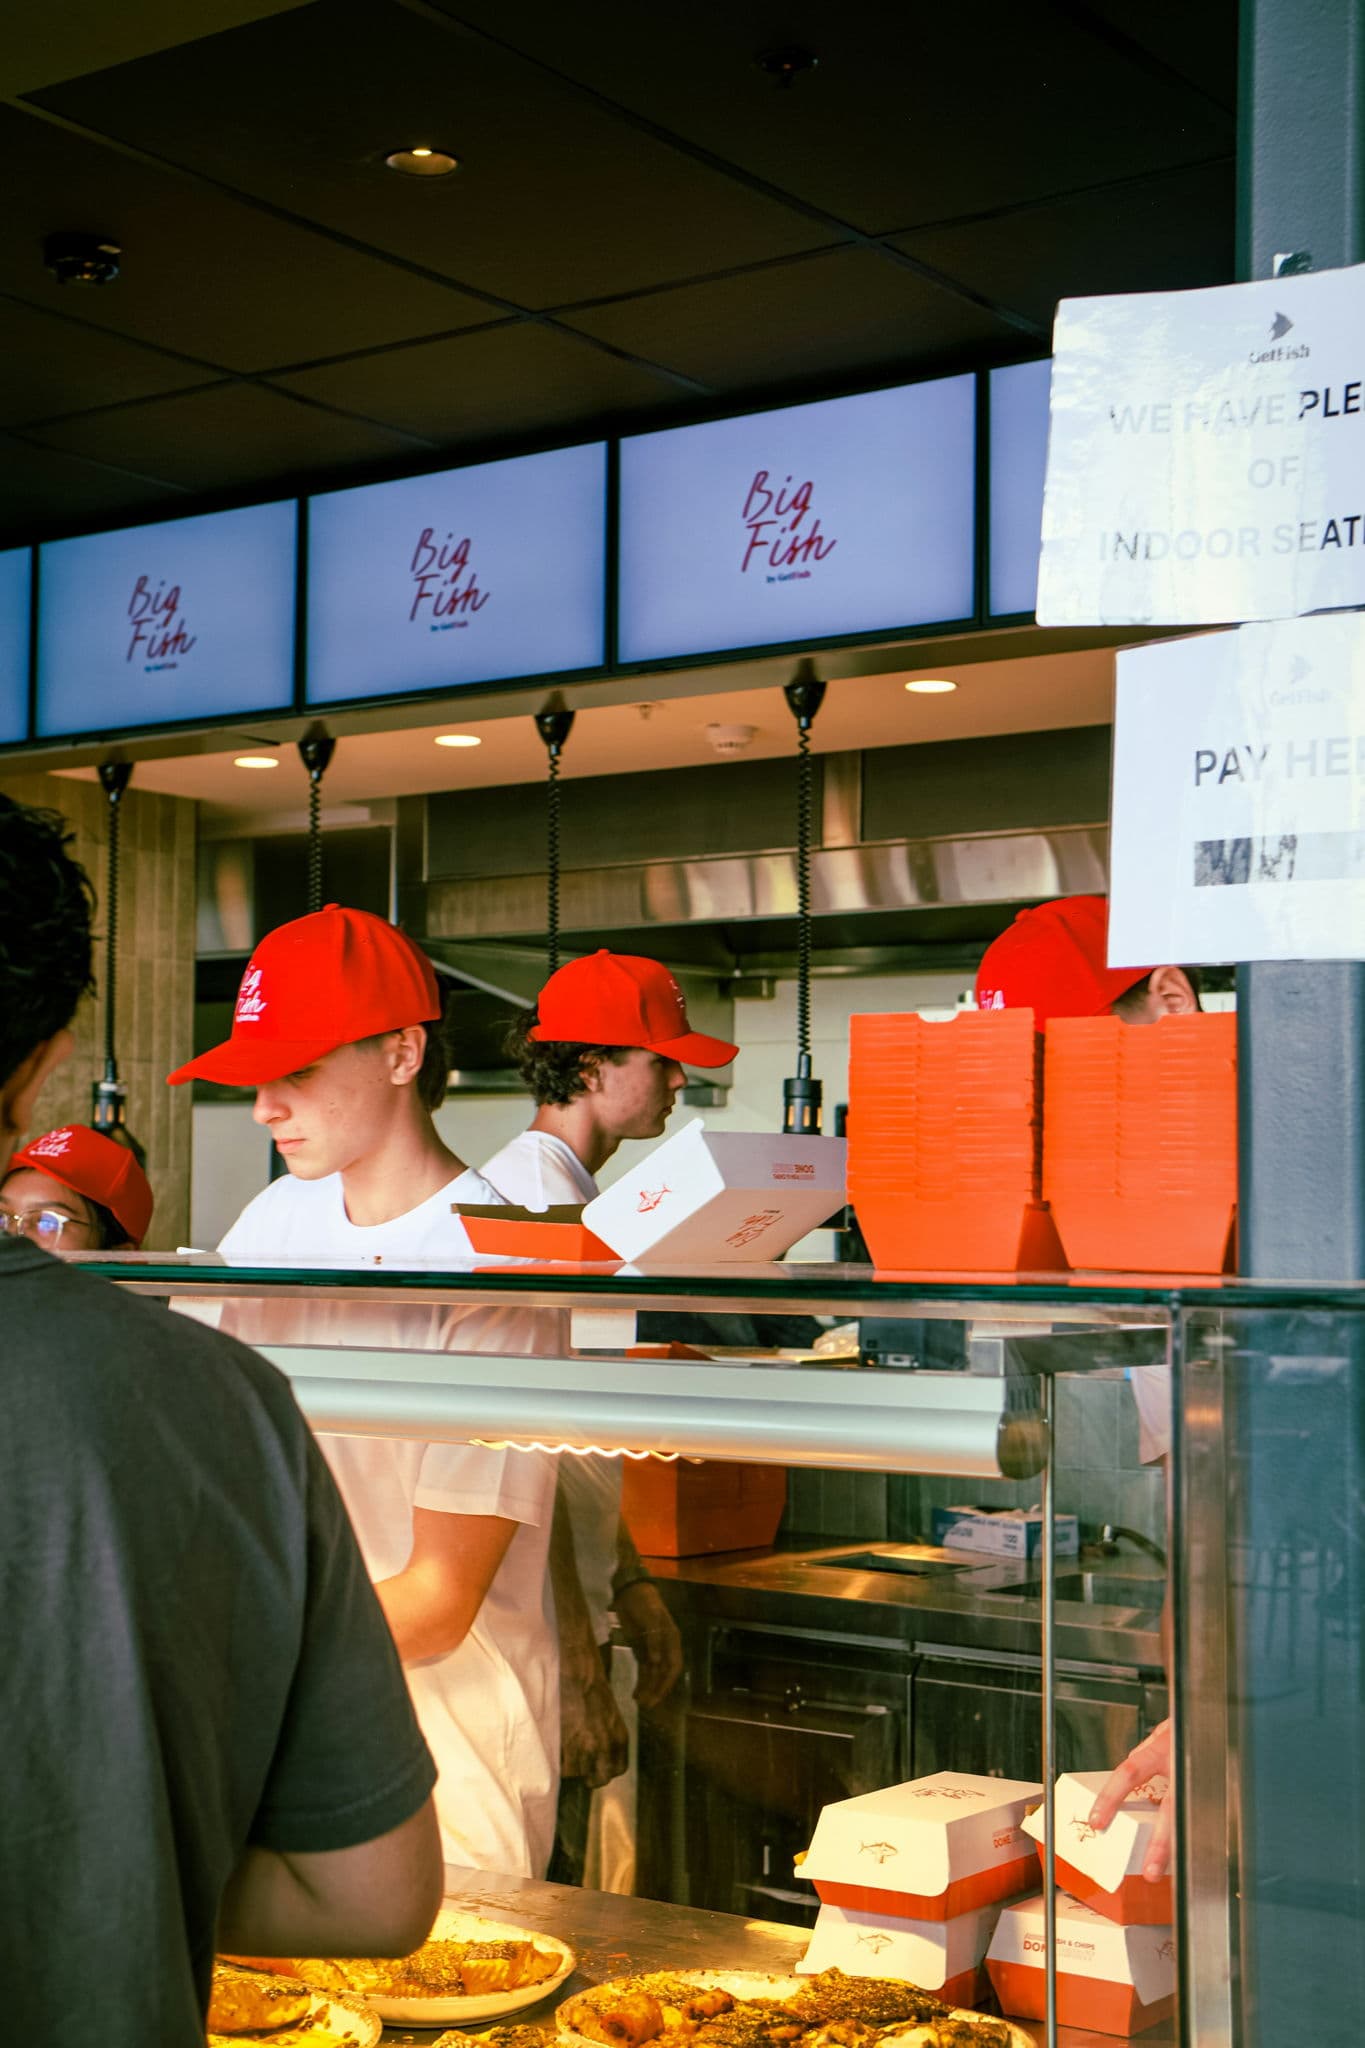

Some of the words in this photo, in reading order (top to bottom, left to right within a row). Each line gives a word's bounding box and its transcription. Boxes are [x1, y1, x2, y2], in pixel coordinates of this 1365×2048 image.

[1109, 403, 1171, 434] WE
[1183, 393, 1285, 433] HAVE
[1299, 381, 1365, 420] PLE
[1248, 456, 1299, 488] OF
[742, 470, 814, 531] Big
[410, 527, 471, 584] Big
[741, 519, 837, 573] Fish
[1100, 527, 1261, 561] INDOOR
[128, 575, 181, 627] Big
[409, 573, 490, 622] Fish
[127, 619, 197, 663] Fish
[1195, 744, 1268, 787] PAY
[1023, 1940, 1046, 1952] DON
